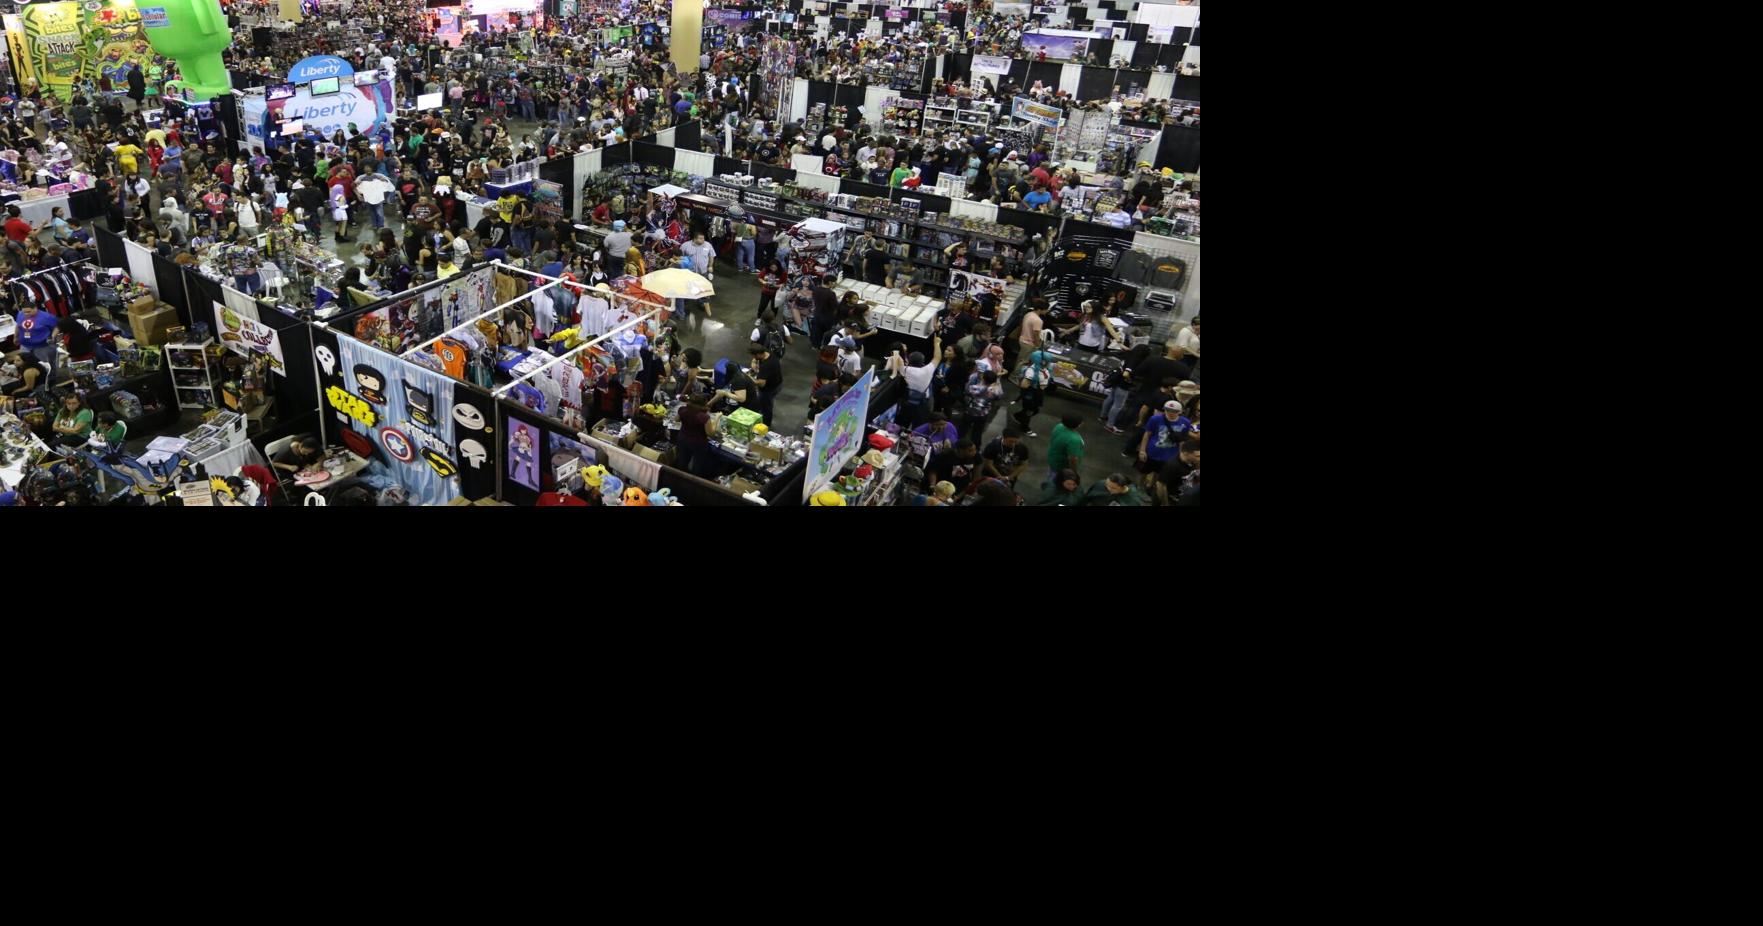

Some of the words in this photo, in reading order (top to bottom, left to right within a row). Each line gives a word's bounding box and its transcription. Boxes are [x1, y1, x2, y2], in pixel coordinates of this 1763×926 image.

[47, 41, 75, 54] ATTACK
[301, 65, 341, 77] Liberty
[293, 101, 357, 120] Liberty
